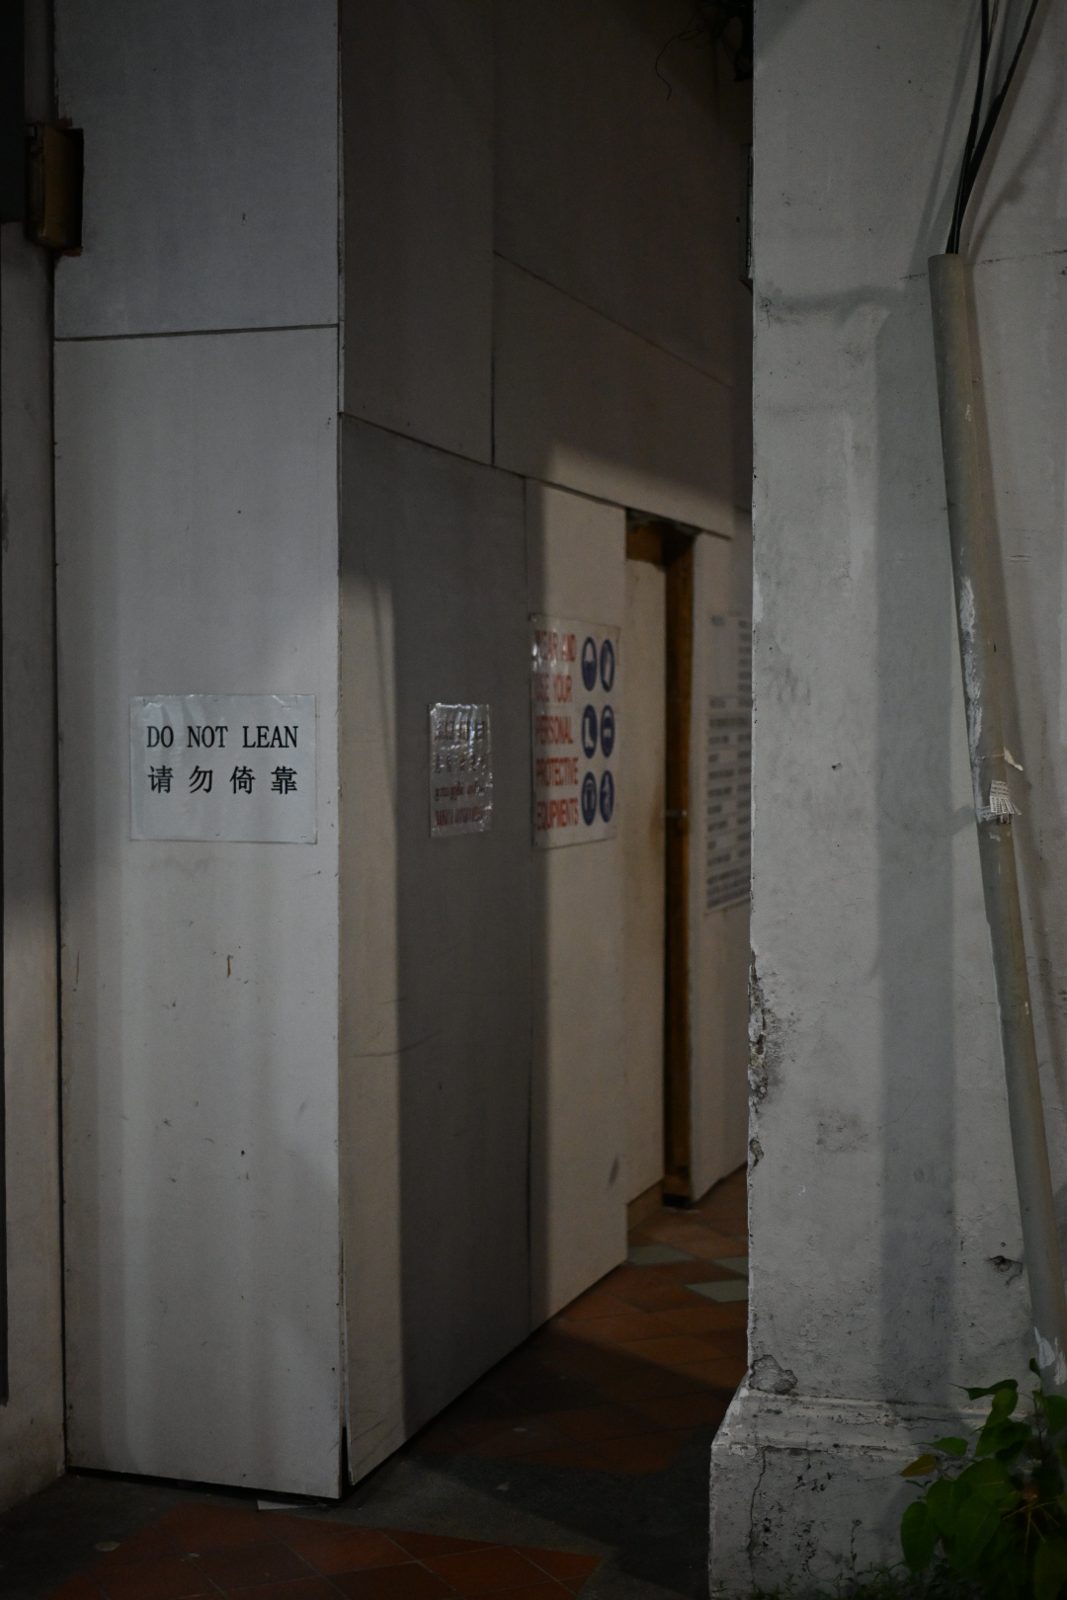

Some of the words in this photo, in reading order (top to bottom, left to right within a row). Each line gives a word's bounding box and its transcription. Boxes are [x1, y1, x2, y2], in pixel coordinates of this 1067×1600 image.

[147, 725, 174, 748] DO
[187, 725, 228, 748] NOT
[242, 725, 299, 748] LEAN
[535, 715, 574, 744] PERSONAL
[148, 765, 298, 794] 请勿倚靠
[536, 756, 579, 787] PROTECTIVE
